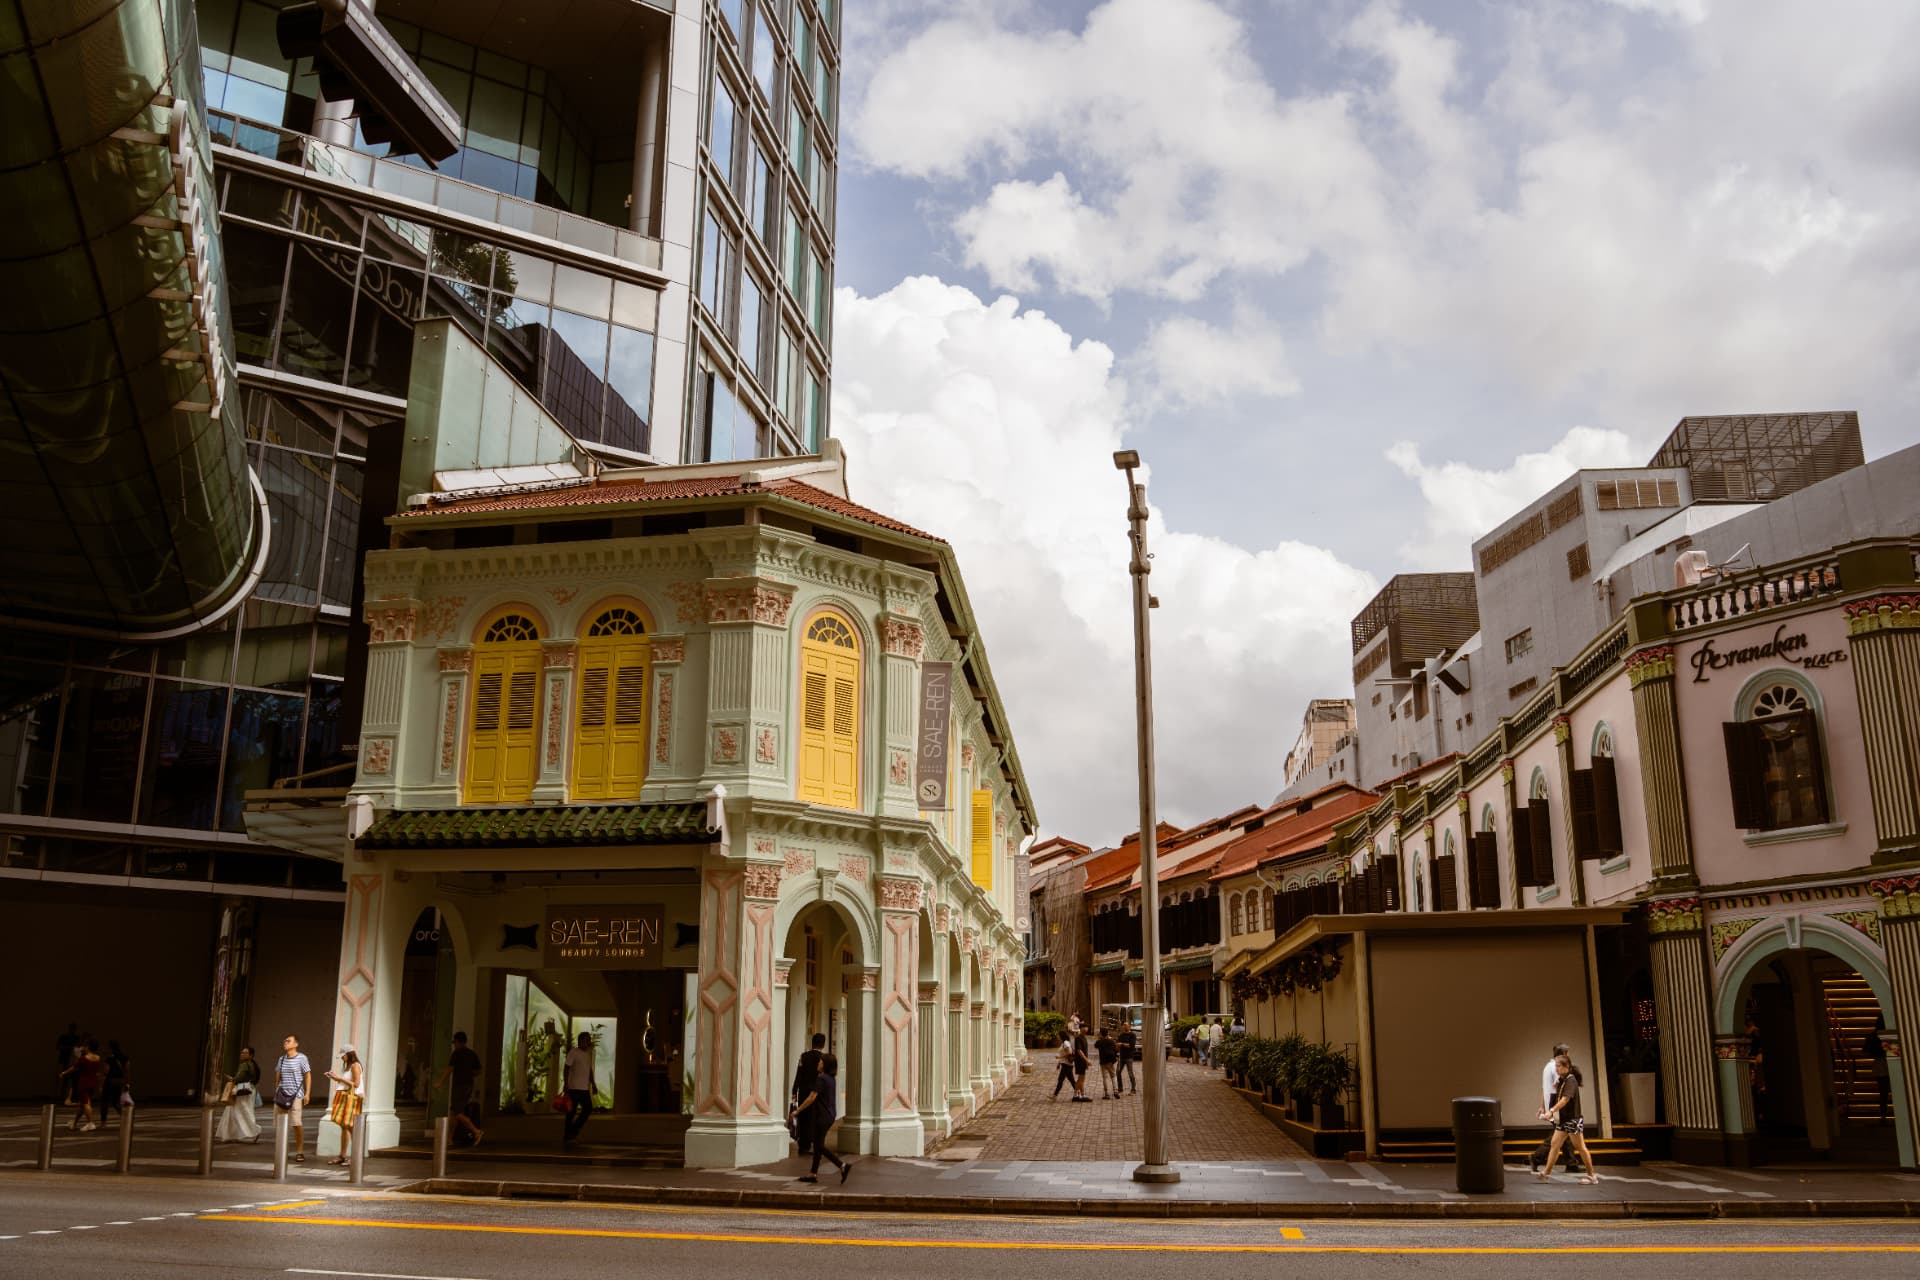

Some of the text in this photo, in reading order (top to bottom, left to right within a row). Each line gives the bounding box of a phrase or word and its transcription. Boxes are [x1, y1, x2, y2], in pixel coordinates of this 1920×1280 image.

[1691, 624, 1848, 683] Peranakan PLACE
[923, 672, 946, 759] SAE-REN
[551, 919, 659, 945] SAE-REN
[560, 947, 600, 958] BEAUTY
